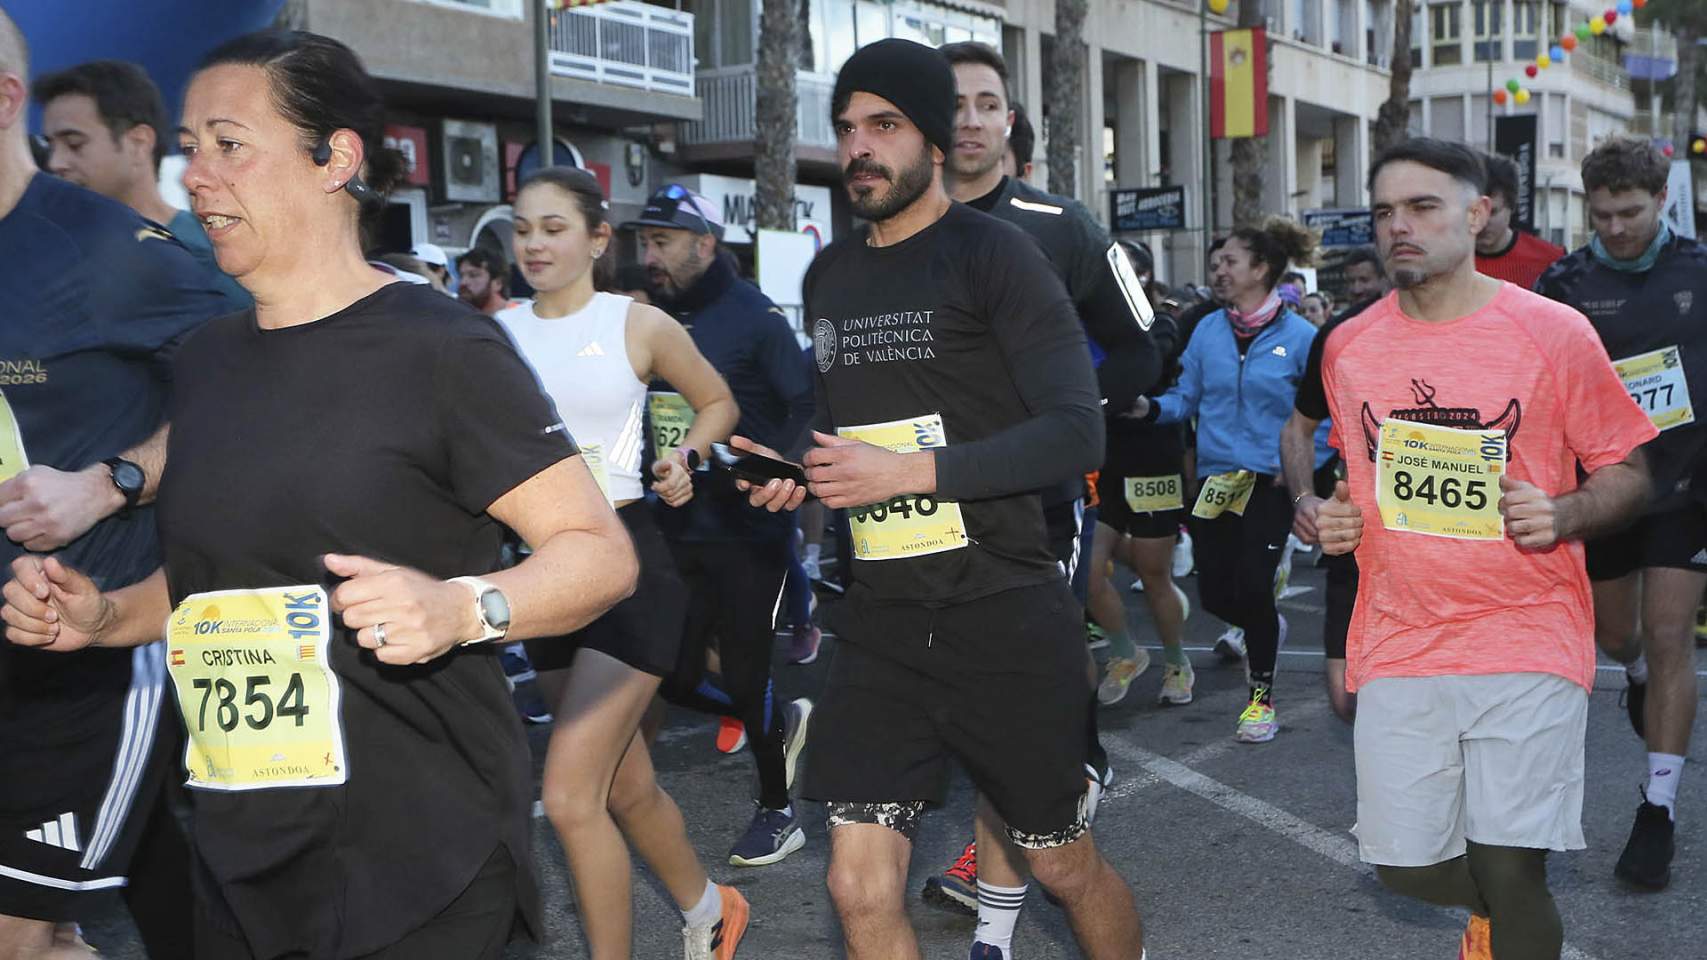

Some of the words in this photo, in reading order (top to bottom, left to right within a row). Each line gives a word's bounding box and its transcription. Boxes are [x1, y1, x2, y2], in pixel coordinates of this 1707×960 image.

[843, 310, 934, 332] UNIVERSITAT
[842, 329, 934, 348] POLITÈCNICA
[844, 352, 861, 366] DE
[866, 346, 935, 362] VALÈNCIA
[1449, 411, 1476, 420] 2024
[654, 426, 690, 447] 62
[1403, 439, 1429, 451] 10K
[1480, 435, 1505, 461] 10K
[1397, 455, 1428, 467] JOSÉ
[1432, 460, 1484, 474] MANUEL
[1134, 480, 1176, 497] 8508
[1394, 470, 1487, 510] 8465
[901, 540, 944, 551] ASTONDOA
[284, 592, 321, 639] 10K
[194, 620, 223, 635] 10K
[202, 649, 276, 666] CRISTINA
[192, 672, 309, 732] 7854
[252, 765, 310, 777] ASTONDOA
